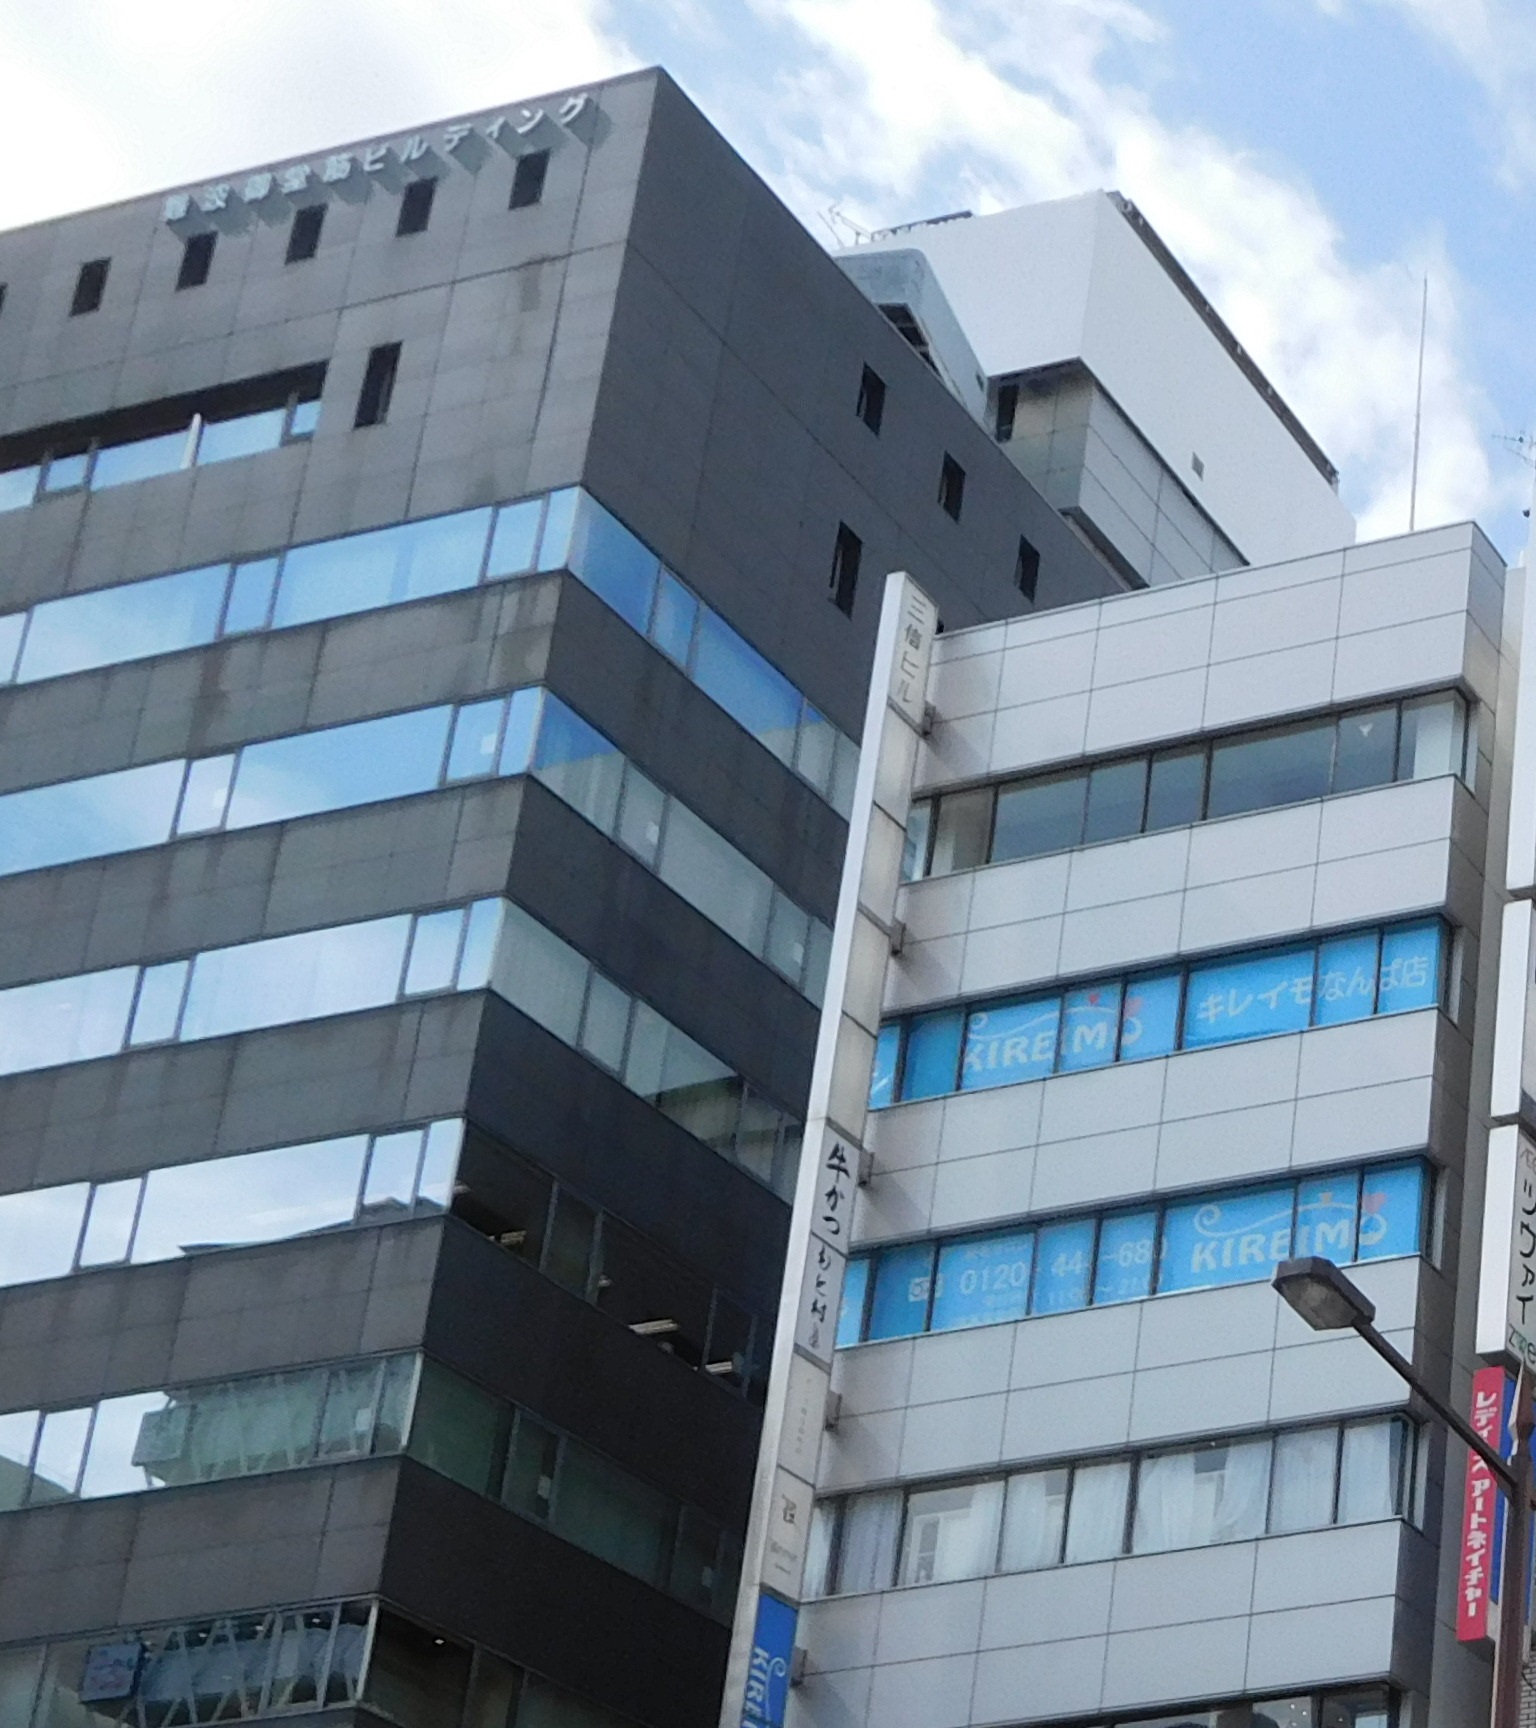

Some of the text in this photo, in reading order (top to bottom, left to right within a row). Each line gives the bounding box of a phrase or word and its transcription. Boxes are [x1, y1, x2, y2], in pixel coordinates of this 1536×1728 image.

[896, 597, 927, 703] 三信ビル
[1198, 956, 1428, 1023] キレイモなんば店
[963, 1018, 1144, 1072] KIREIMO
[824, 1142, 850, 1235] 牛かつ
[1193, 1214, 1387, 1273] KIREIMO
